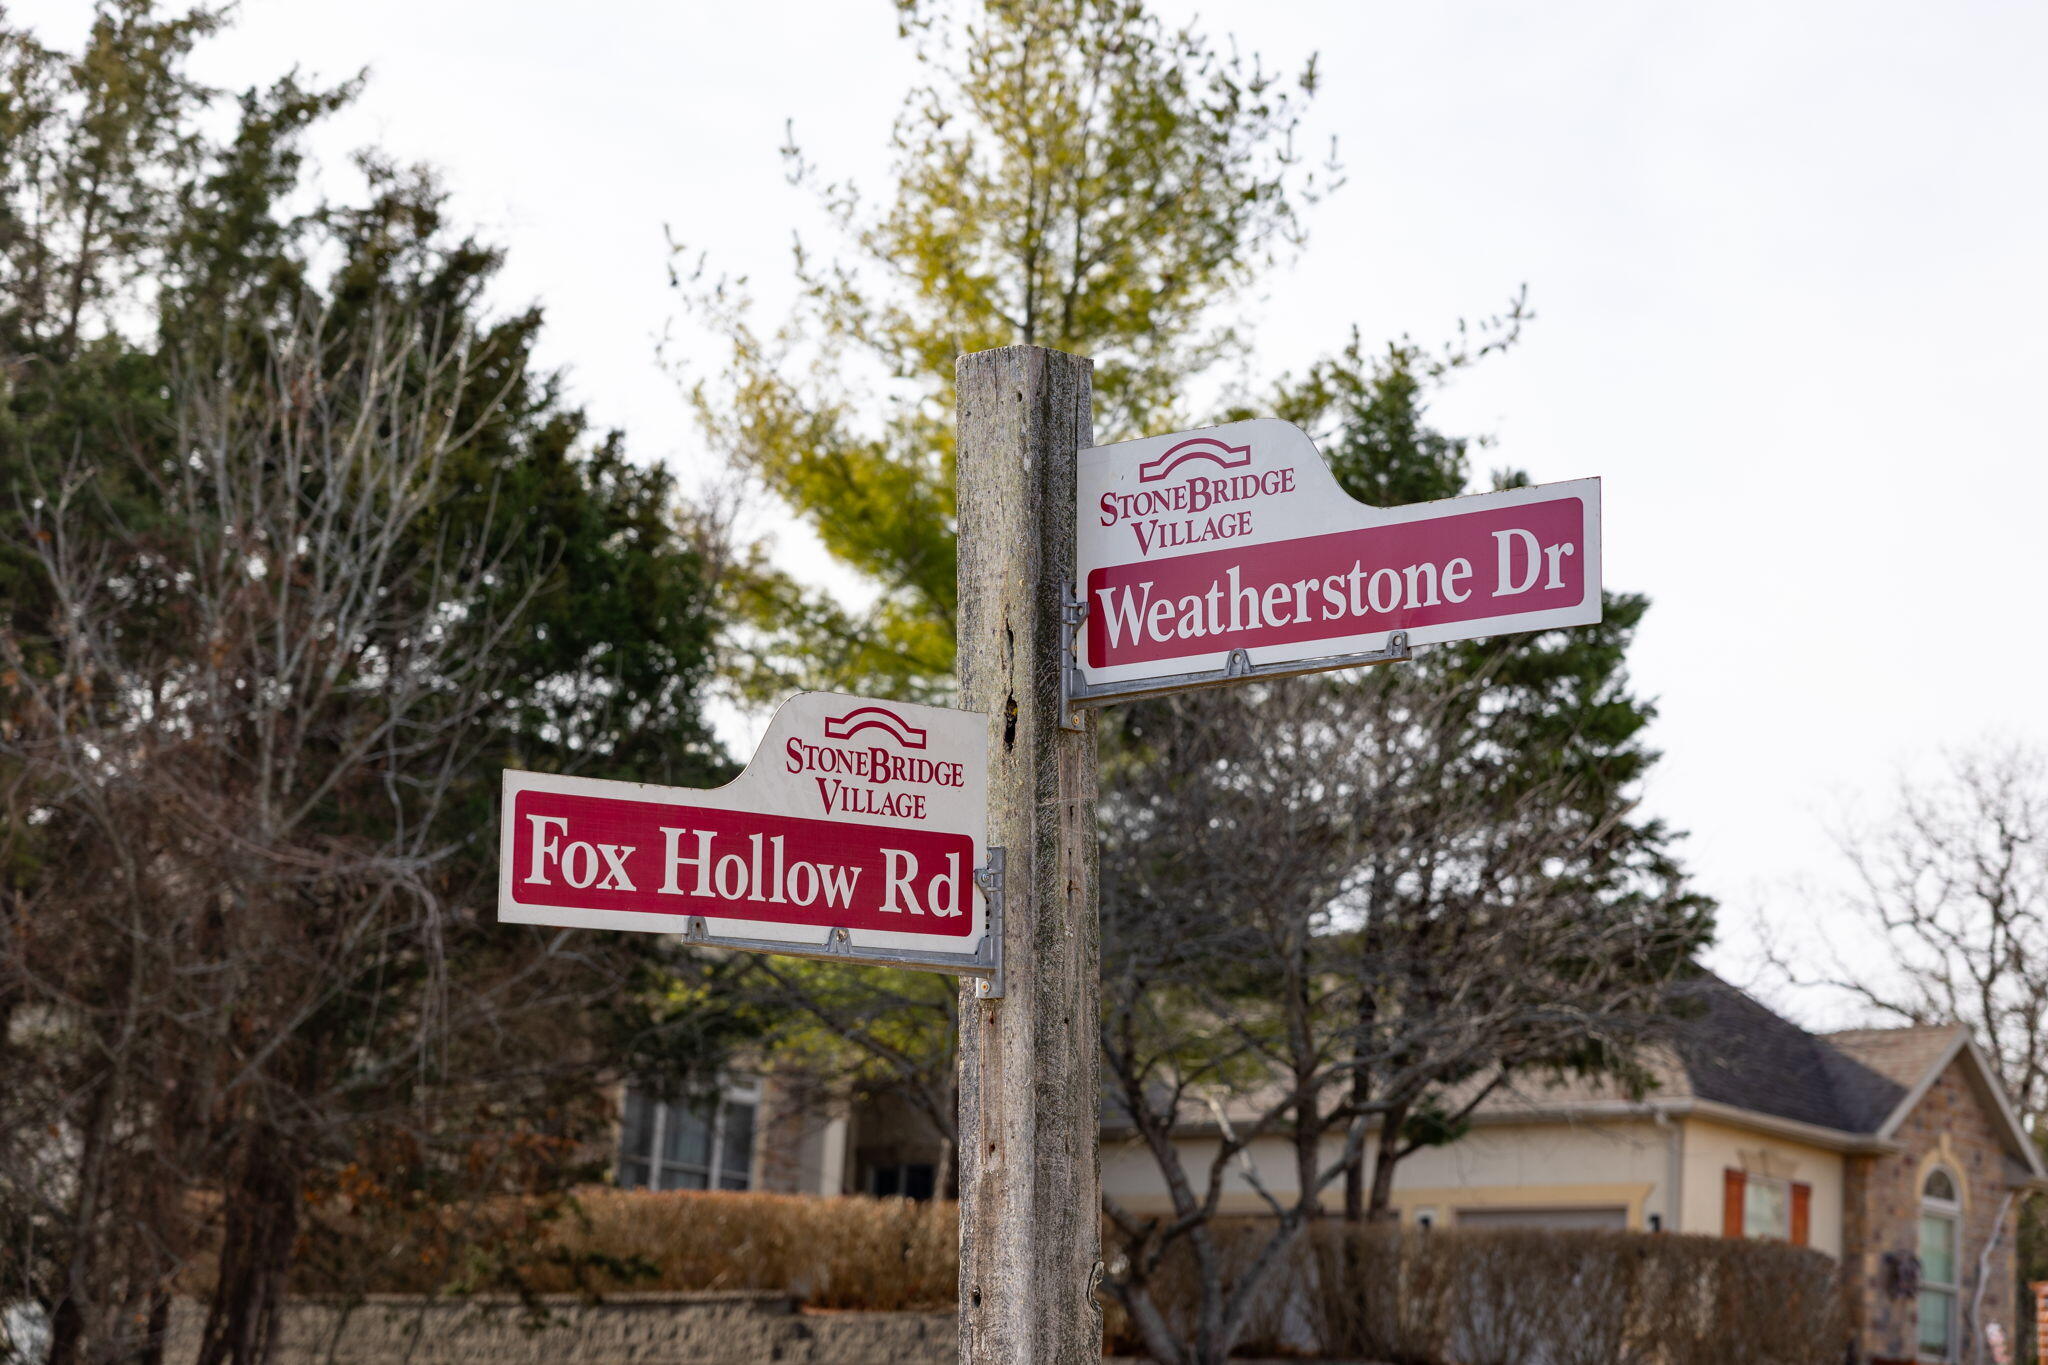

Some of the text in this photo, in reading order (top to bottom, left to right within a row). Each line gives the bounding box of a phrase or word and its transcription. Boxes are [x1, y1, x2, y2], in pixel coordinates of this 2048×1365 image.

[1131, 510, 1253, 556] VILLAGE
[1095, 528, 1575, 650] Weatherstone Dr
[815, 777, 927, 820] VILLAGE
[524, 813, 963, 918] Fox Hollow Rd
